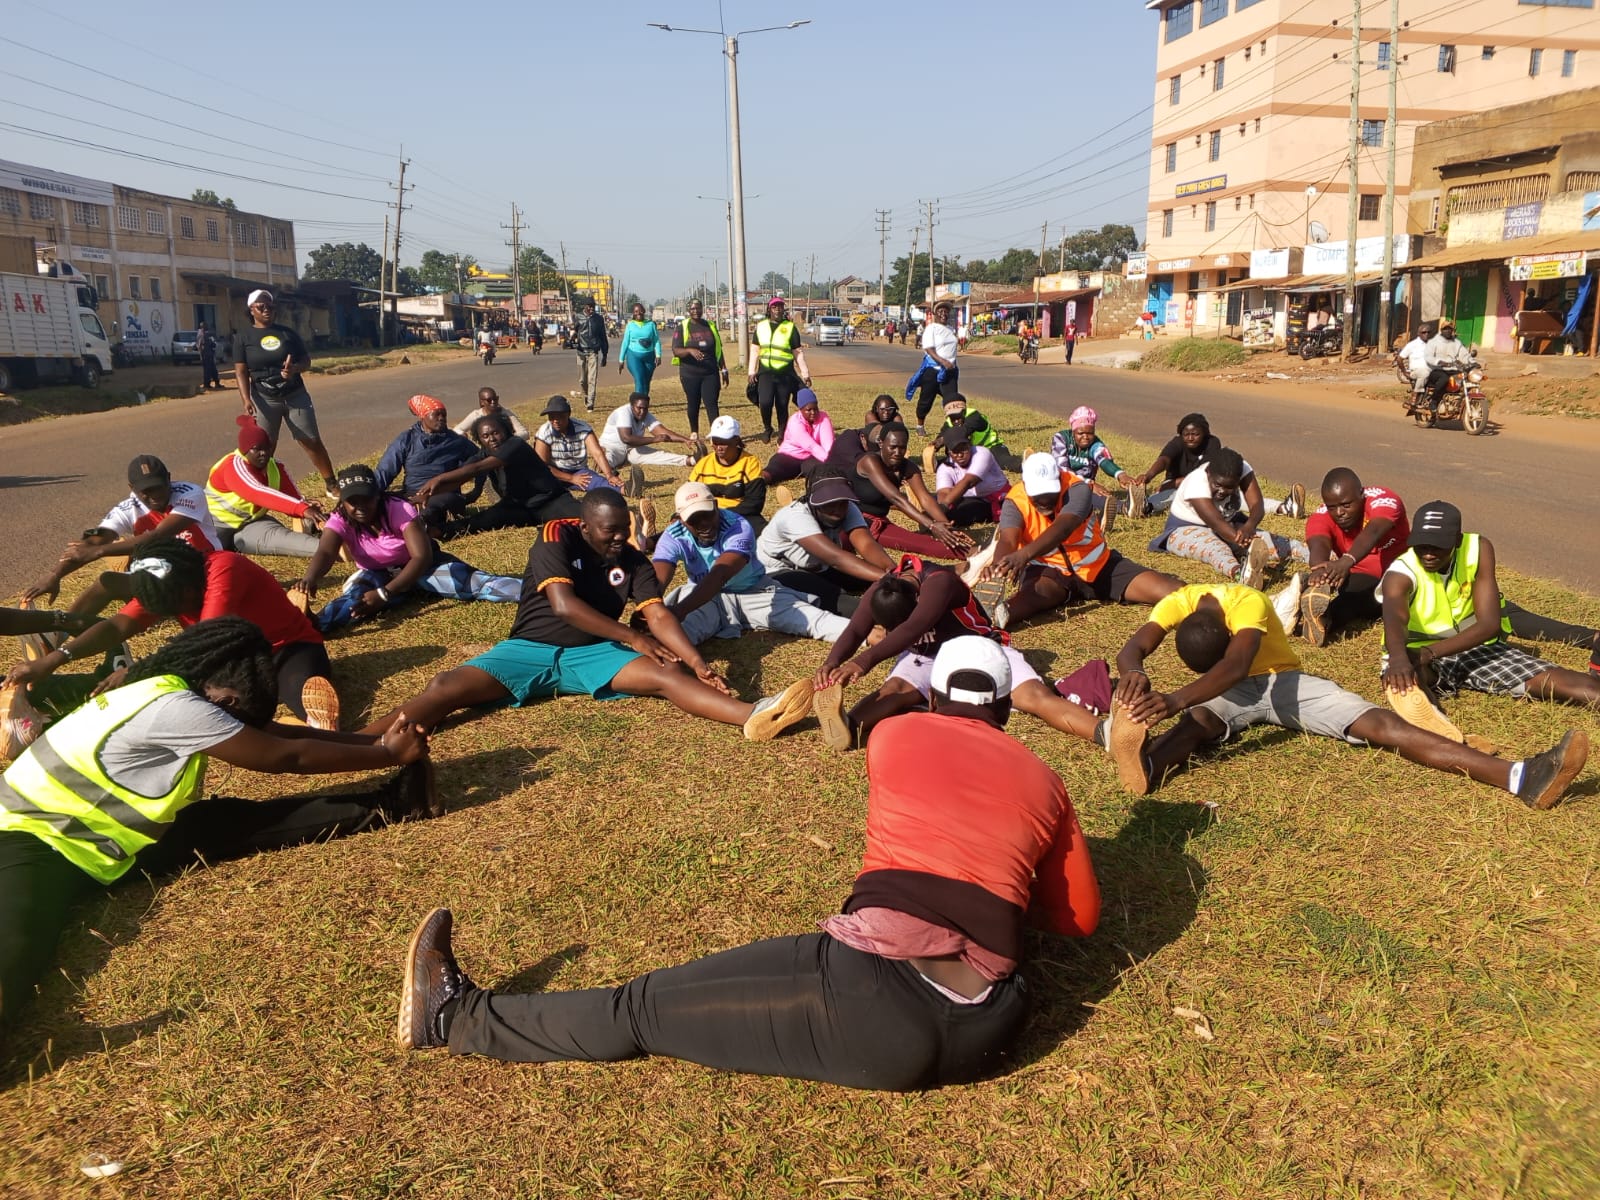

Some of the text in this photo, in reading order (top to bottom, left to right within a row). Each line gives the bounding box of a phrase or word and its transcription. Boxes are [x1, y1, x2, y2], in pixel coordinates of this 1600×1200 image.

[21, 177, 77, 195] WHOLESALE
[1506, 225, 1534, 240] SALON
[0, 292, 47, 314] AK
[338, 475, 373, 489] Star
